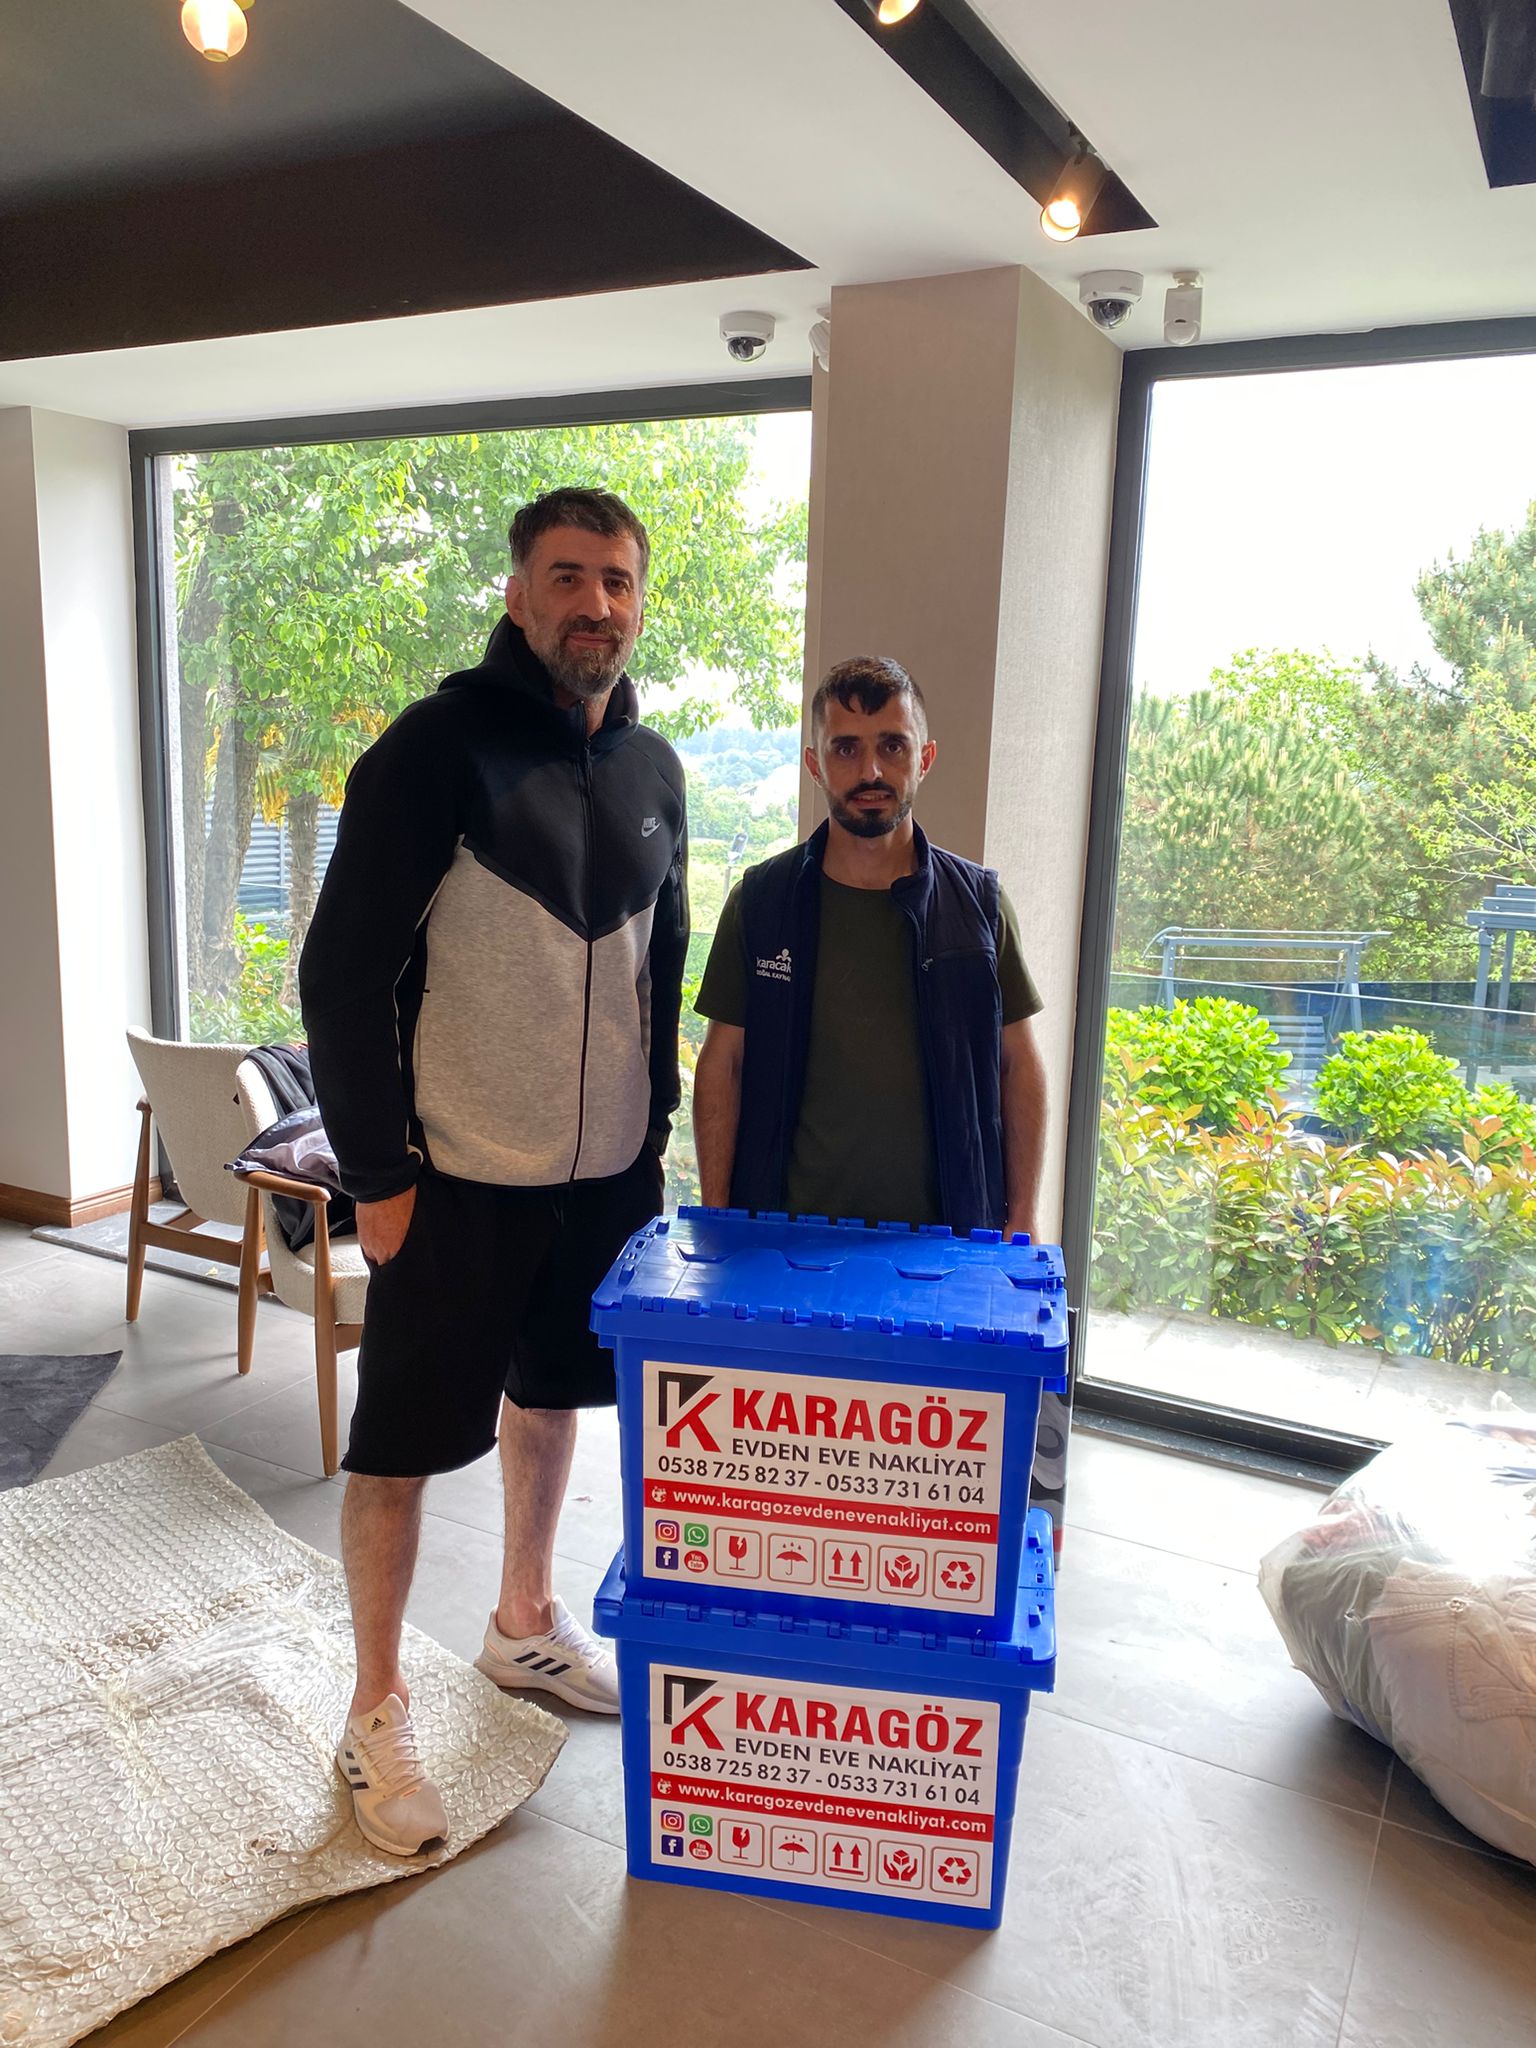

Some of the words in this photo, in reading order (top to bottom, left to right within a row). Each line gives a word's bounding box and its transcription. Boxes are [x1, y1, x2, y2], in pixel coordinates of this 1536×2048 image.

[732, 1386, 989, 1453] KARAGÖZ
[658, 1455, 708, 1477] 0538
[713, 1461, 750, 1482] 725
[755, 1466, 779, 1485] 82
[785, 1469, 810, 1488] 37
[827, 1473, 879, 1495] 0533
[884, 1479, 920, 1499] 731
[927, 1483, 950, 1502] 61
[958, 1486, 985, 1505] 04
[732, 1437, 810, 1463] EVDEN
[819, 1447, 861, 1468] EVE
[869, 1452, 987, 1479] NAKLİYAT
[673, 1490, 991, 1536] www.karagozevdenevenakliyat.com
[735, 1691, 984, 1758] KARAGÖZ
[663, 1750, 712, 1772] 0538
[717, 1758, 753, 1778] 725
[757, 1763, 781, 1782] 82
[786, 1767, 811, 1785] 37
[827, 1772, 878, 1794] 0533
[883, 1779, 917, 1799] 731
[925, 1784, 947, 1802] 61
[954, 1787, 980, 1806] 04
[735, 1737, 811, 1762] EVDEN
[819, 1747, 861, 1768] EVE
[868, 1753, 982, 1782] NAKLİYAT
[678, 1784, 986, 1833] www.karagozevdenevenakliyat.com
